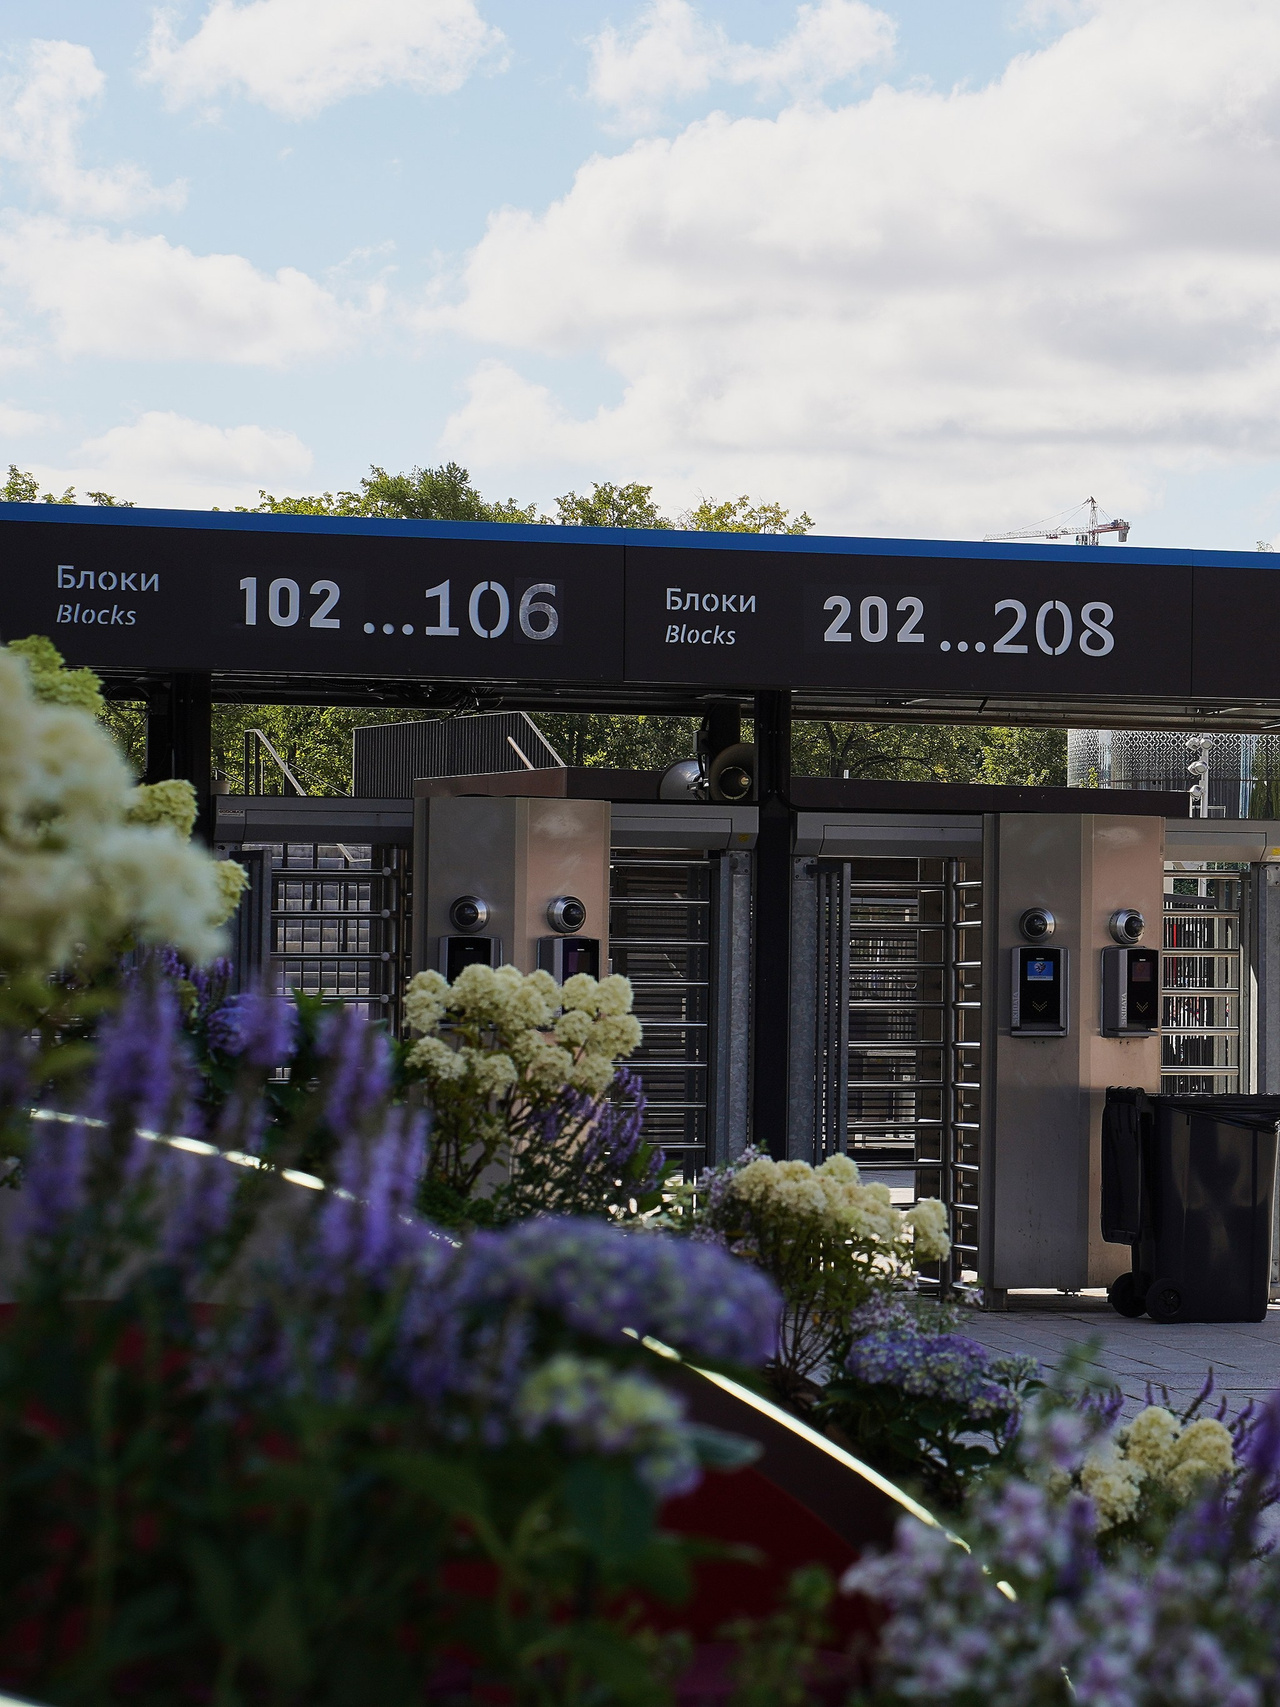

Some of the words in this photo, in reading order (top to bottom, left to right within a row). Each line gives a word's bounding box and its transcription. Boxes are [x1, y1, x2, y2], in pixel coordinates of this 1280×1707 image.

[57, 564, 159, 592] Блоки
[239, 576, 341, 629] 102
[666, 587, 756, 613] Блоки
[56, 603, 136, 626] Blocks
[823, 595, 925, 644] 202
[665, 623, 737, 645] Blocks
